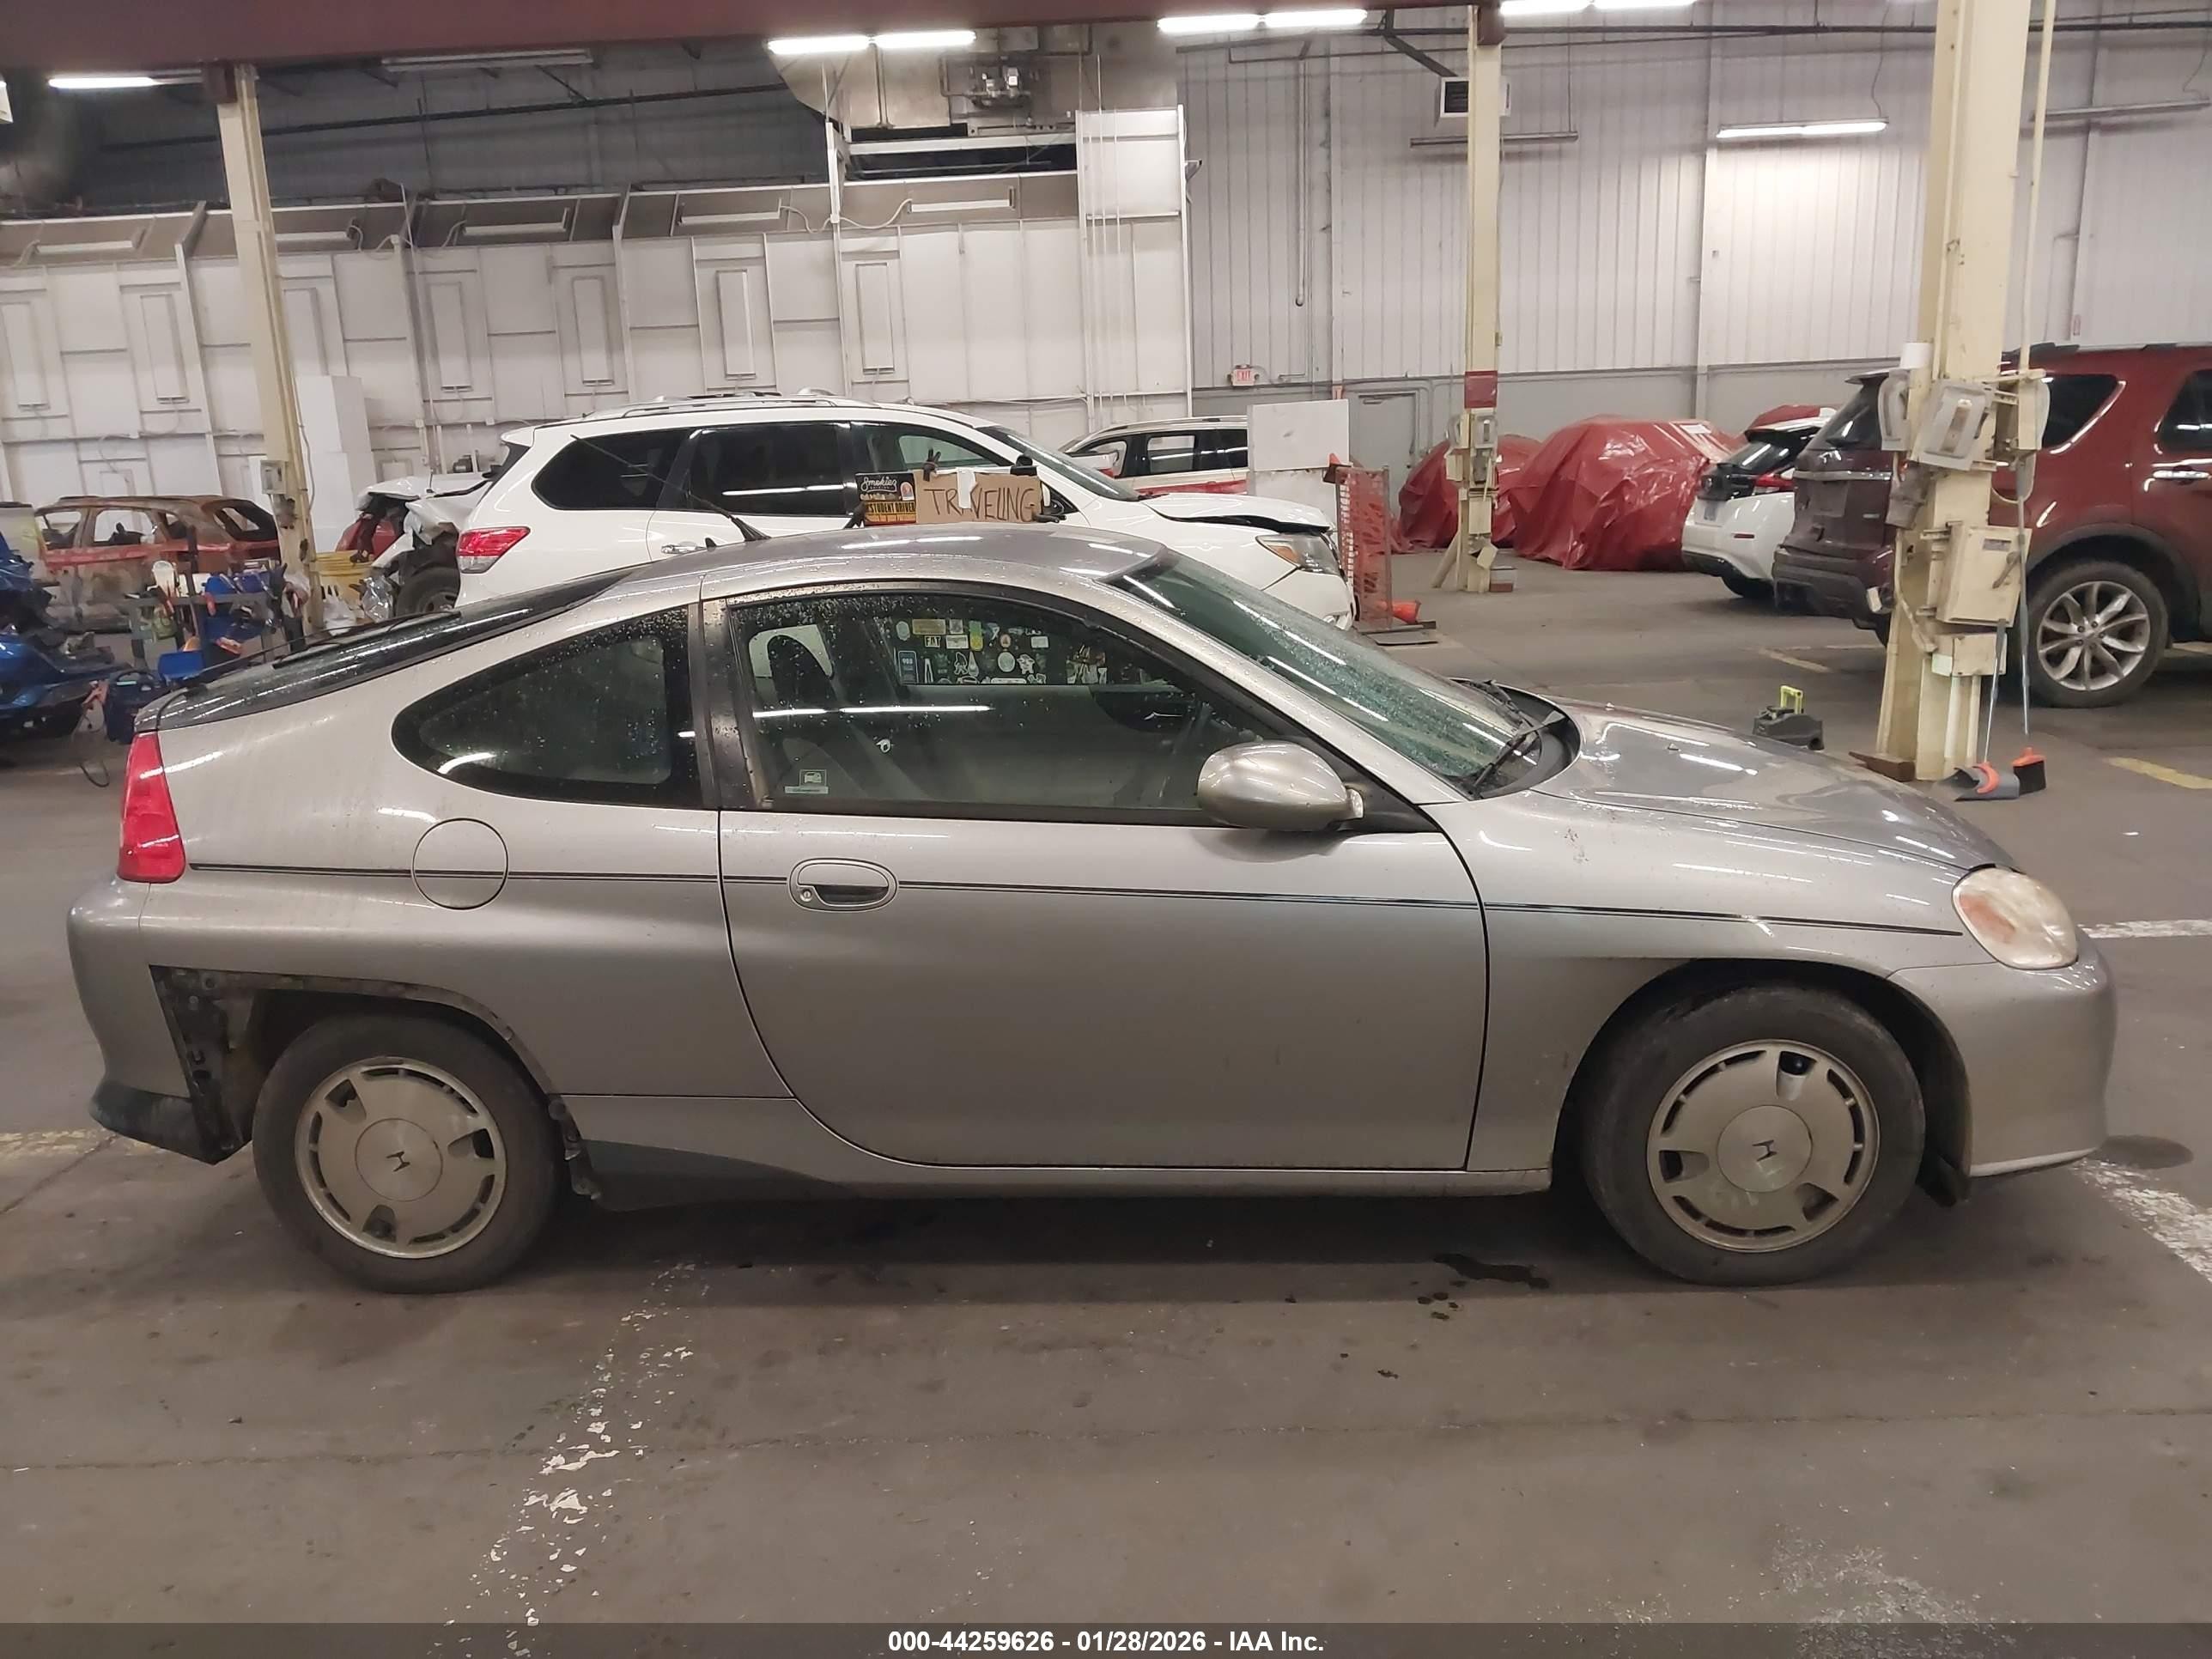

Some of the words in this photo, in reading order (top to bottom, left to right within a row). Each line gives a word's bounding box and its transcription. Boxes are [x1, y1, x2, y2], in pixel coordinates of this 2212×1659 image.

[871, 502, 893, 513] STUDENT
[923, 486, 1035, 522] TRVELING
[926, 636, 940, 647] FAT
